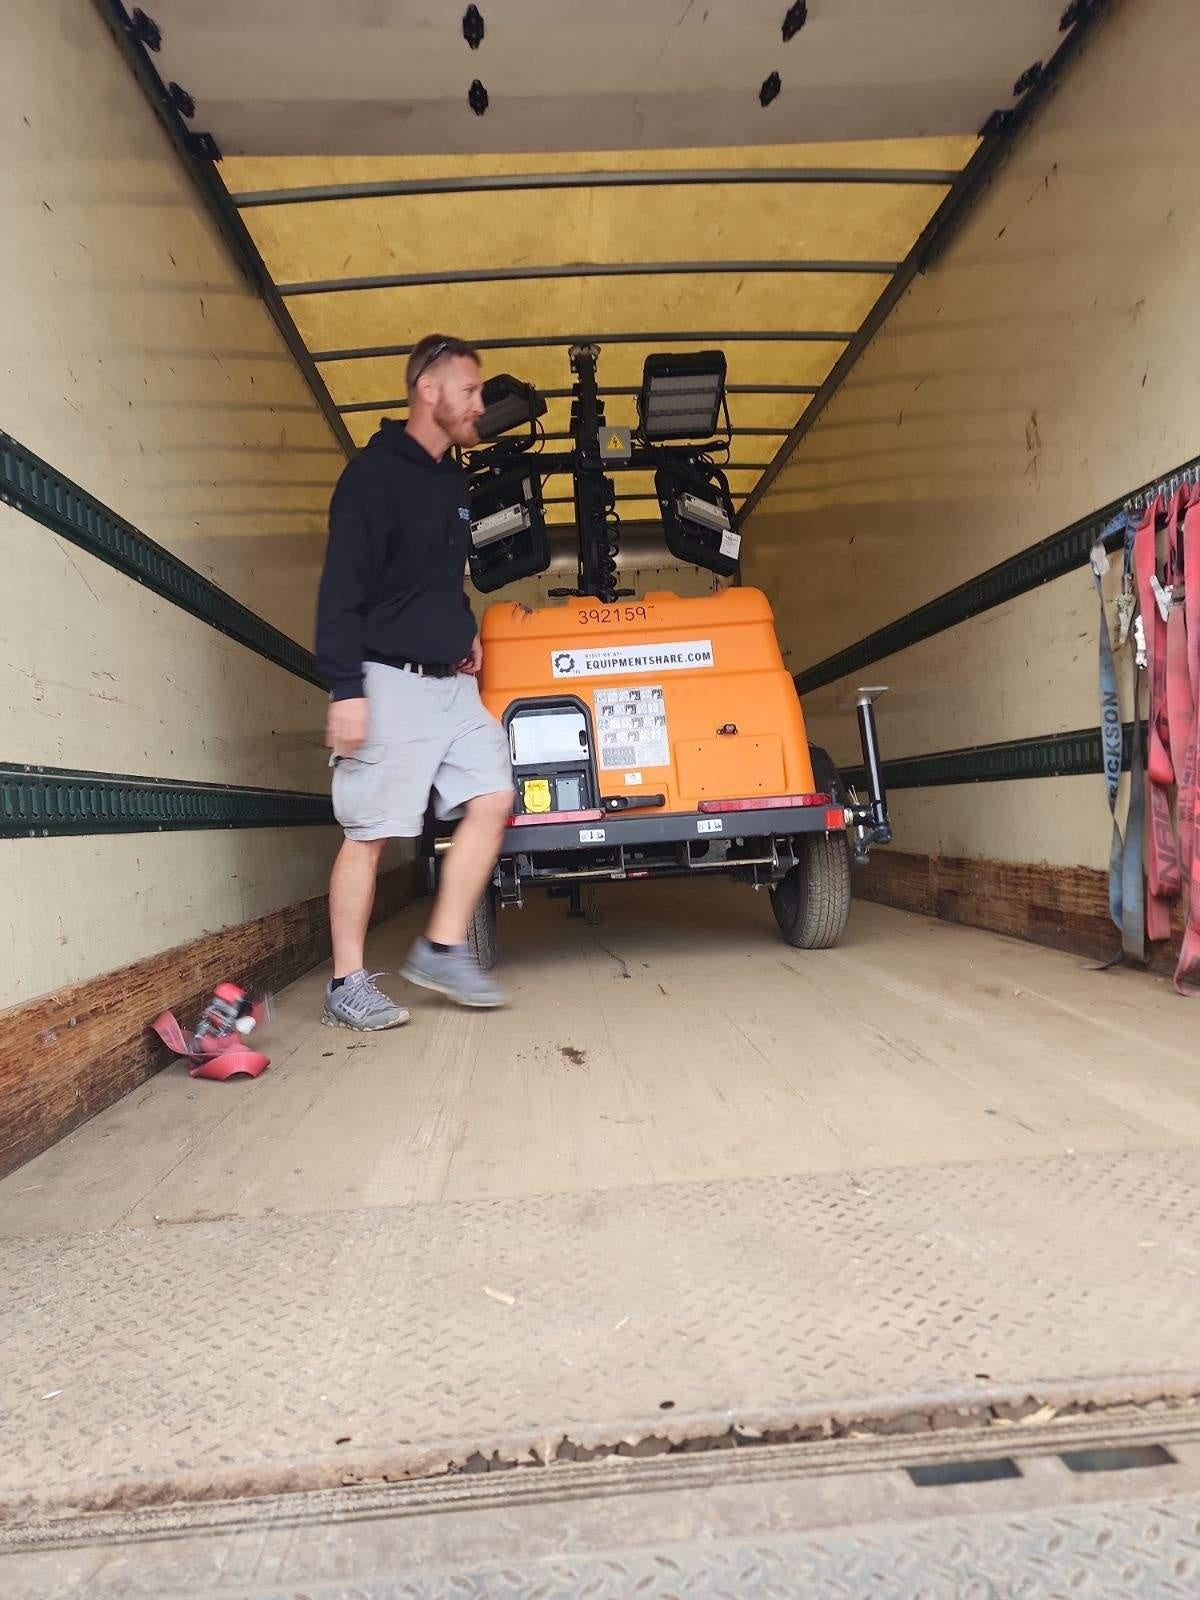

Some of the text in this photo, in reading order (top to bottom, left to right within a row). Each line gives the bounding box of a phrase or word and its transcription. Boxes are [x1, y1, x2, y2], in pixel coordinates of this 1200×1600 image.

[578, 606, 647, 625] 392159
[586, 652, 711, 670] EQUIPMENTSHARE.COM
[1102, 690, 1120, 811] RICKSON
